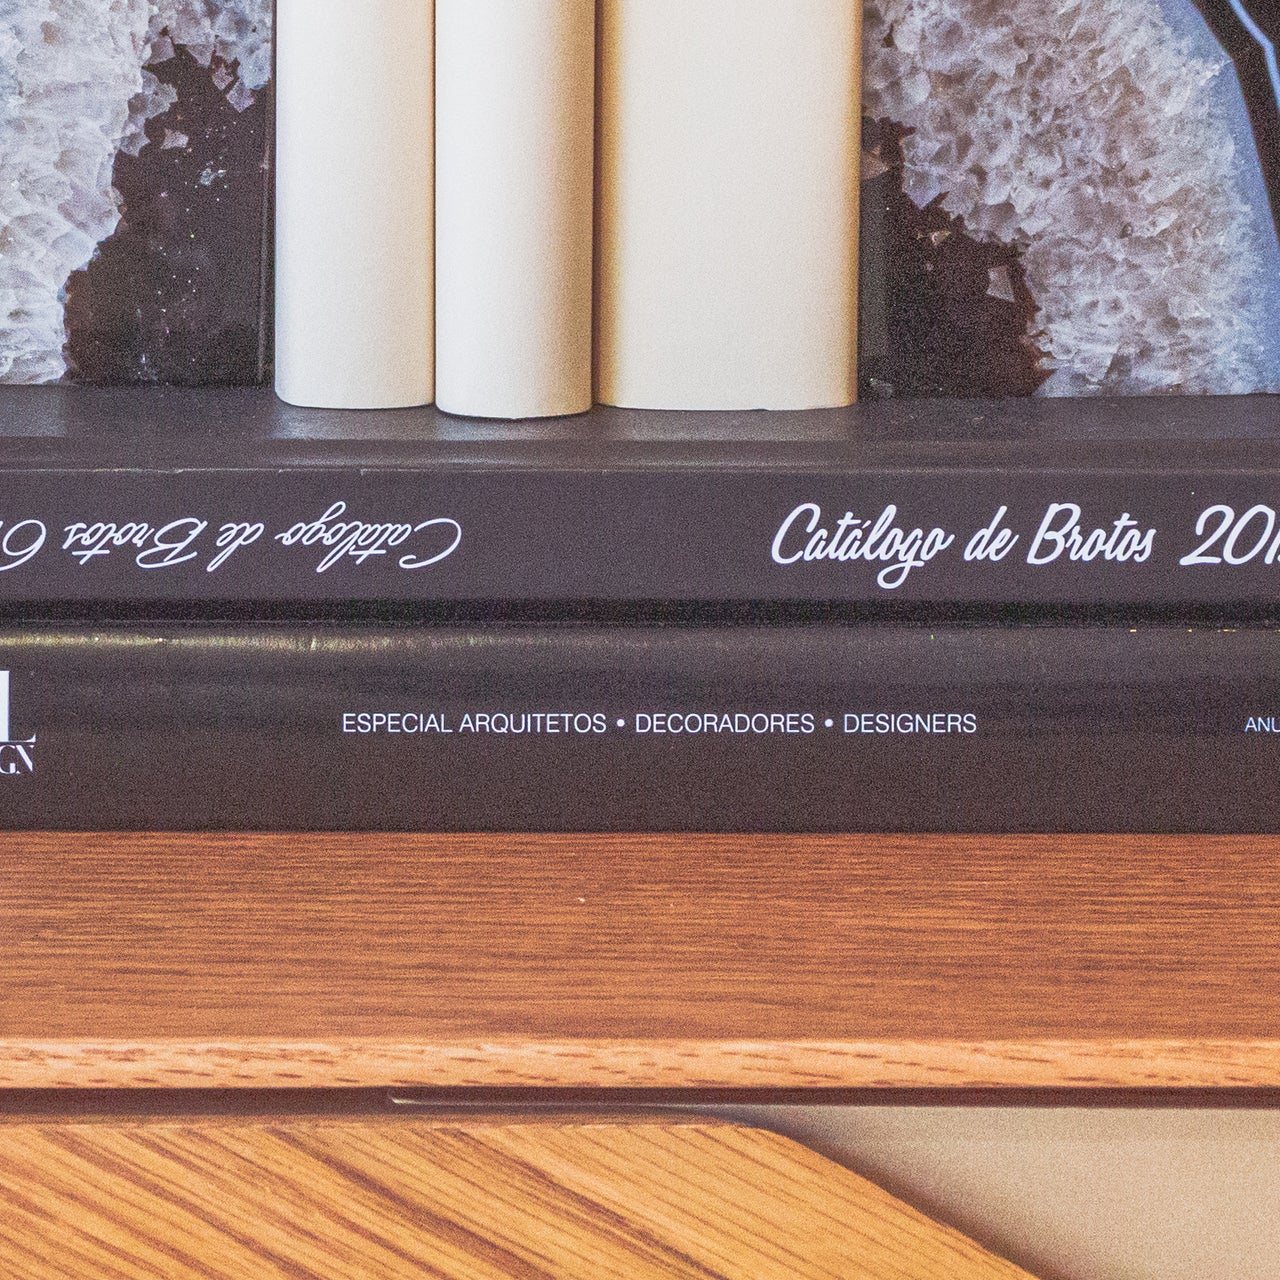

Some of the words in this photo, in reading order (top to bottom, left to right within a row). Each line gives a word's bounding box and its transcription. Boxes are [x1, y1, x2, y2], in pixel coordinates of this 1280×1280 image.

[62, 517, 208, 569] Brotos
[206, 522, 265, 573] de
[771, 502, 955, 590] Catálogo
[963, 505, 1020, 562] de
[1026, 502, 1157, 565] Brotos
[342, 712, 453, 733] ESPECIAL
[458, 712, 608, 735] ARQUITETOS
[634, 712, 816, 734] DECORADORES
[843, 712, 978, 734] DESIGNERS
